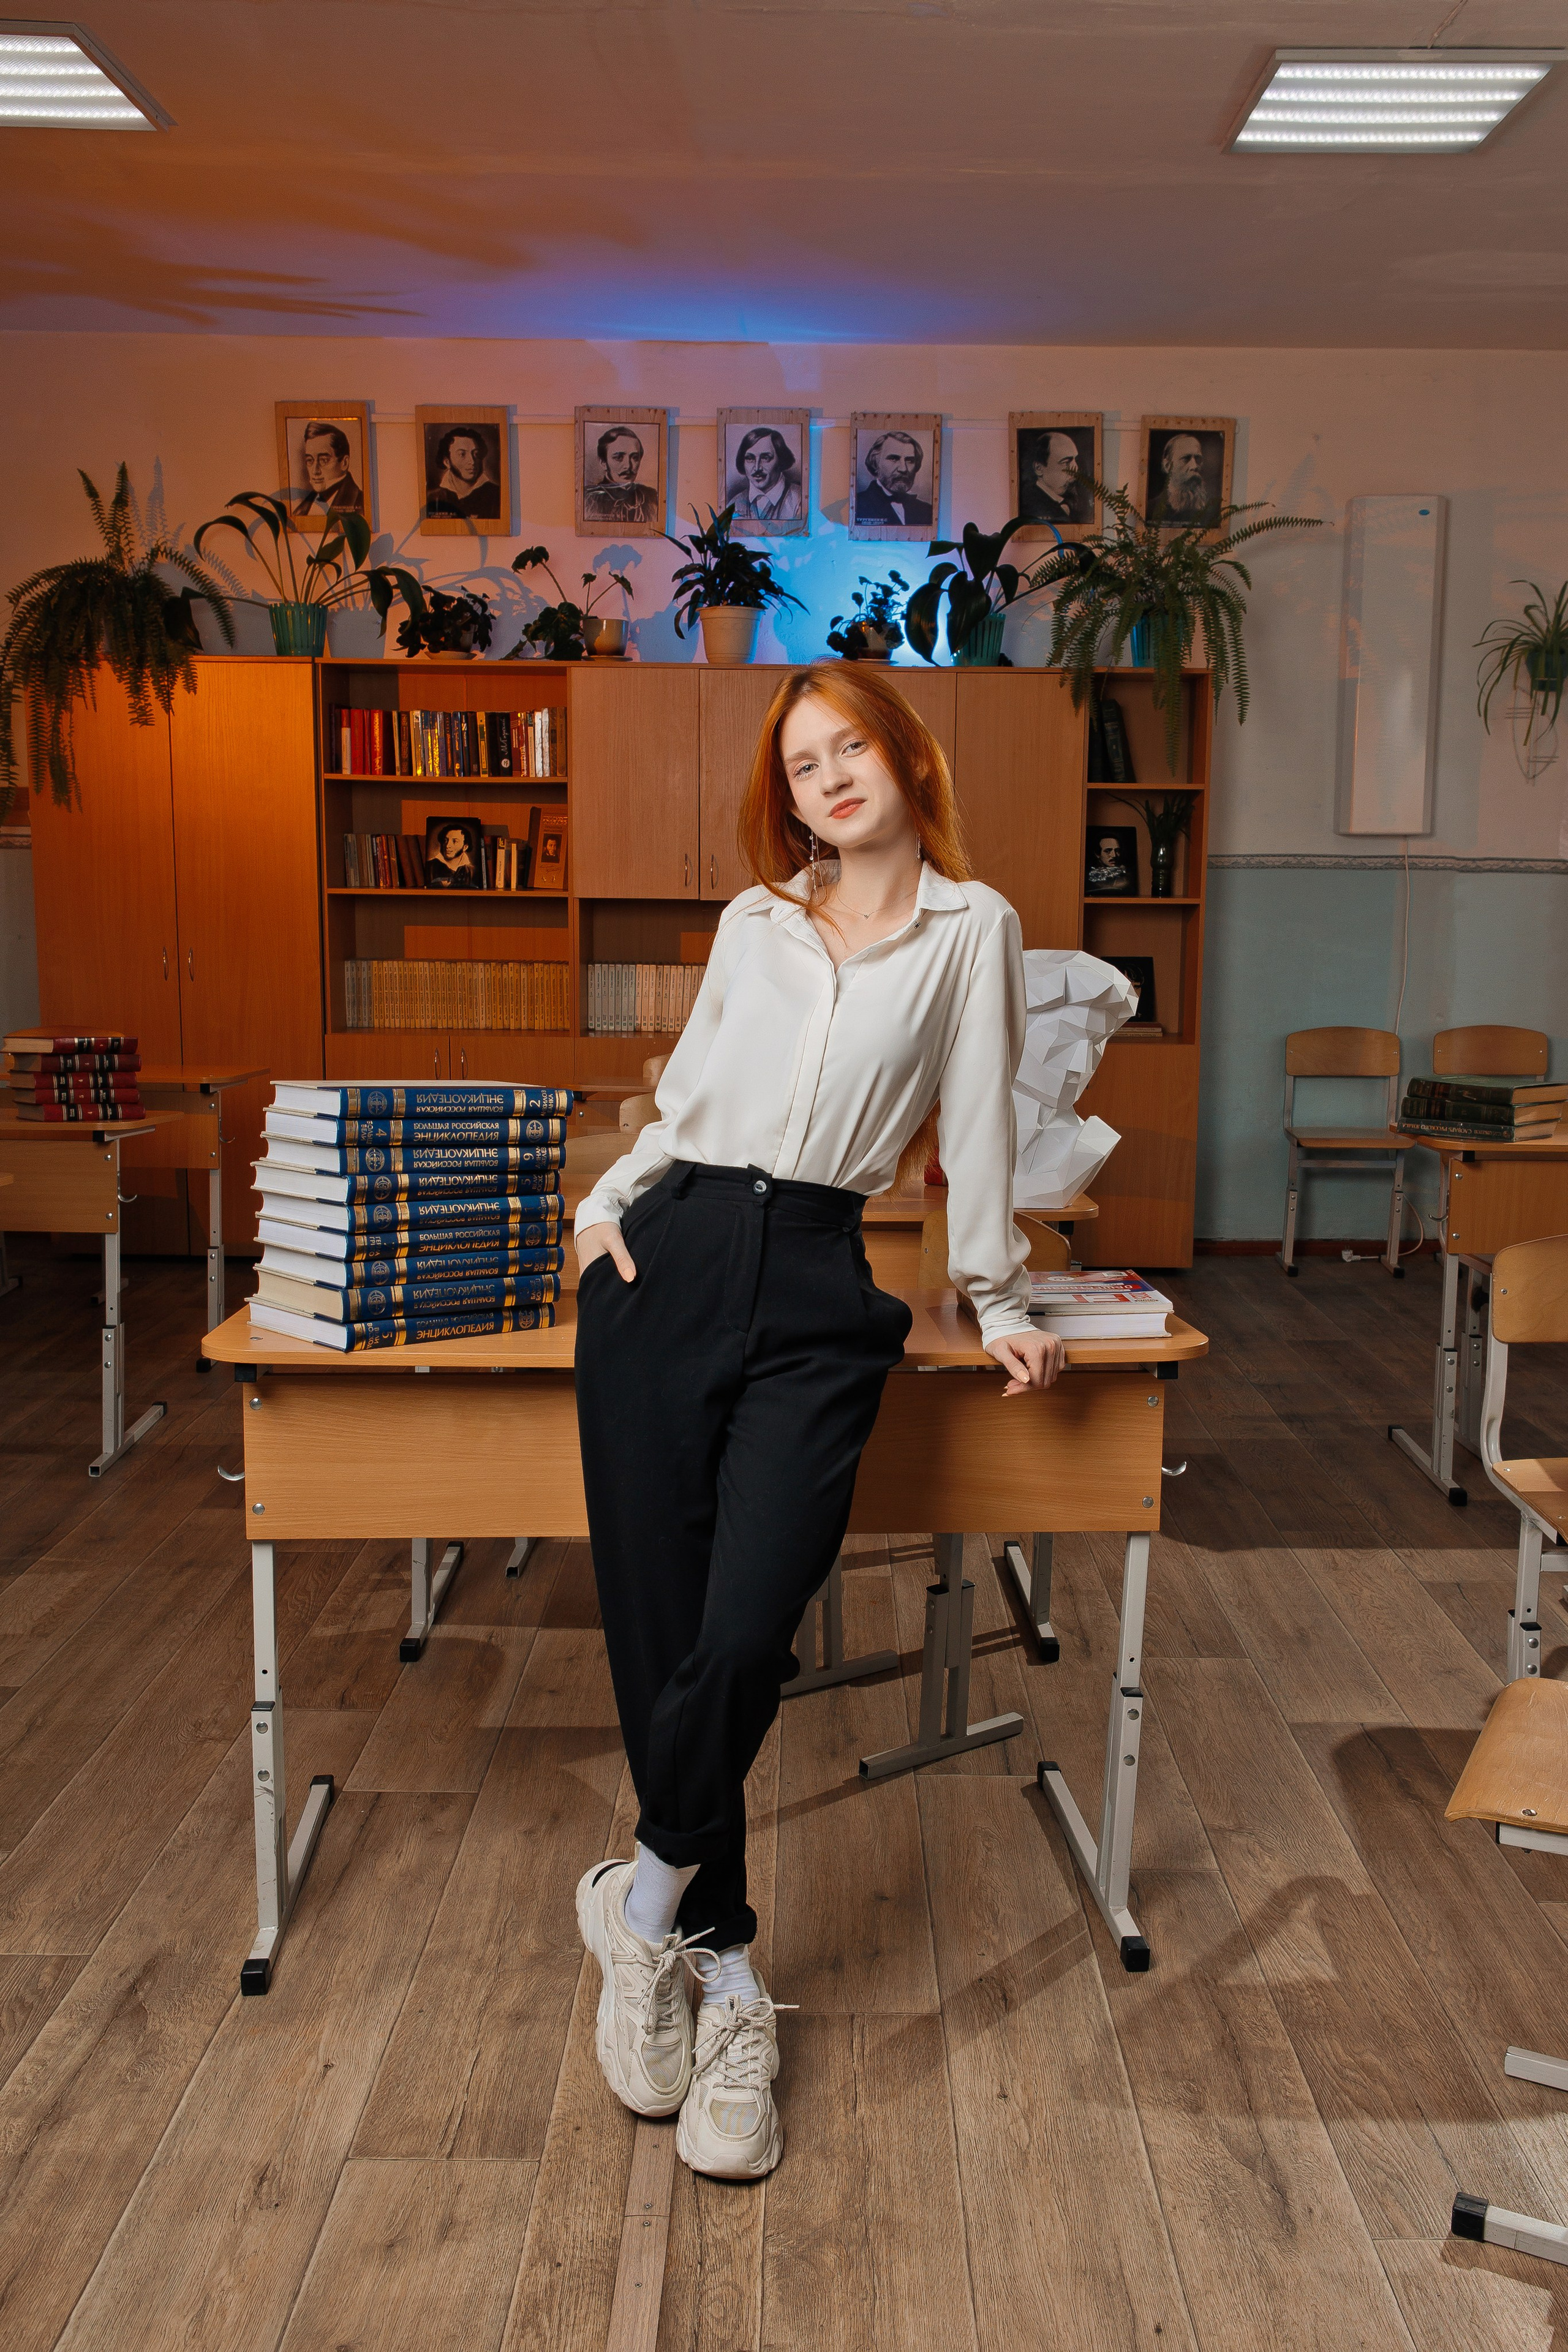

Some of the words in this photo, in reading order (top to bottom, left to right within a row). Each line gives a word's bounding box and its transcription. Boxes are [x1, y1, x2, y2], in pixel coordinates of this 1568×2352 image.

[417, 1094, 504, 1104] ЭНЦИКЛОПЕДИЯ
[451, 1121, 499, 1129] РОССИЙСКАЯ
[413, 1132, 499, 1141] ЭНЦИКЛОПЕДИЯ
[413, 1148, 499, 1159] ЭНЦИКЛОПЕДИЯ
[523, 1152, 535, 1161] 9
[413, 1160, 462, 1169] РОССИЙСКАЯ
[418, 1174, 498, 1187] ЭНЦИКЛОПЕДИЯ
[418, 1202, 501, 1216] ЭНЦИКЛОПЕДИЯ
[419, 1231, 453, 1241] БОЛЬШАЯ
[455, 1229, 500, 1239] РОССИЙСКАЯ
[419, 1240, 500, 1252] ЭНЦИКЛОПЕДИЯ
[413, 1284, 495, 1300] ЭНЦИКЛОПЕДИЯ
[462, 1296, 495, 1305] БОЛЬШАЯ
[416, 1321, 494, 1340] ЭНЦИКЛОПЕДИЯ
